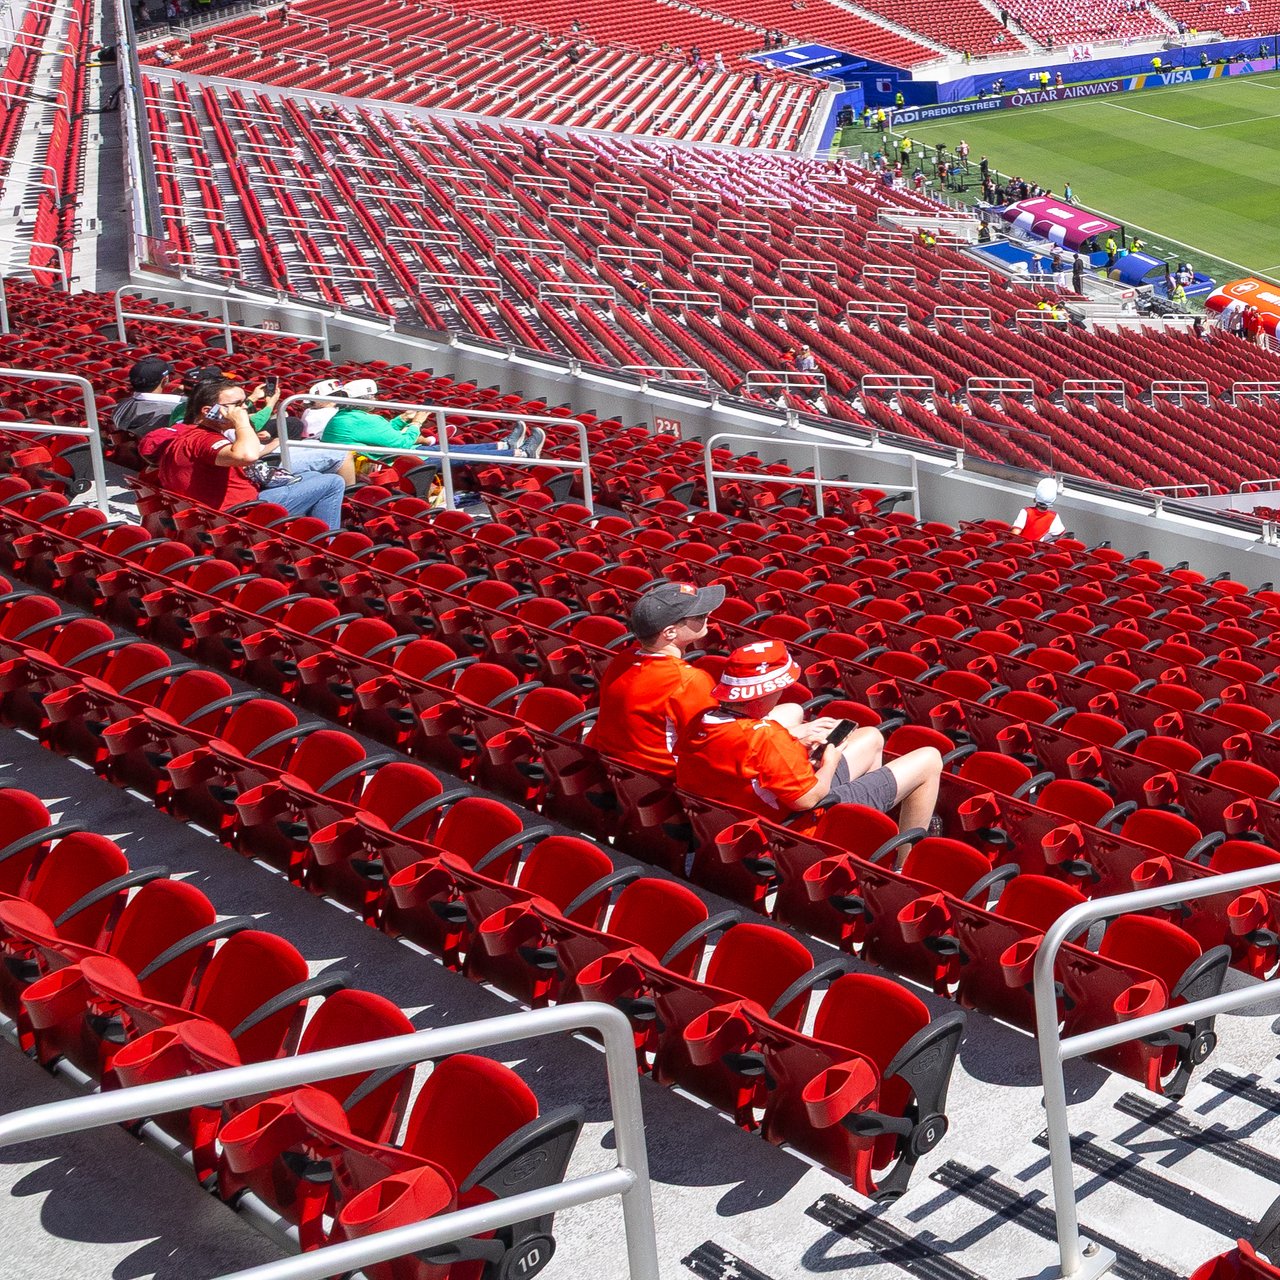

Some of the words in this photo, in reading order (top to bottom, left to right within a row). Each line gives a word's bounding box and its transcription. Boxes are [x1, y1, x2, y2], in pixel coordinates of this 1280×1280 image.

[1029, 71, 1051, 82] FIA
[1162, 71, 1193, 85] VISA
[1011, 87, 1058, 106] QATAR
[1064, 79, 1118, 100] AIRWAYS
[893, 110, 919, 125] ADI
[922, 100, 1001, 121] PREDICTSTREET
[728, 673, 795, 700] SUISSE
[926, 1127, 935, 1142] 9
[518, 1248, 540, 1273] 10
